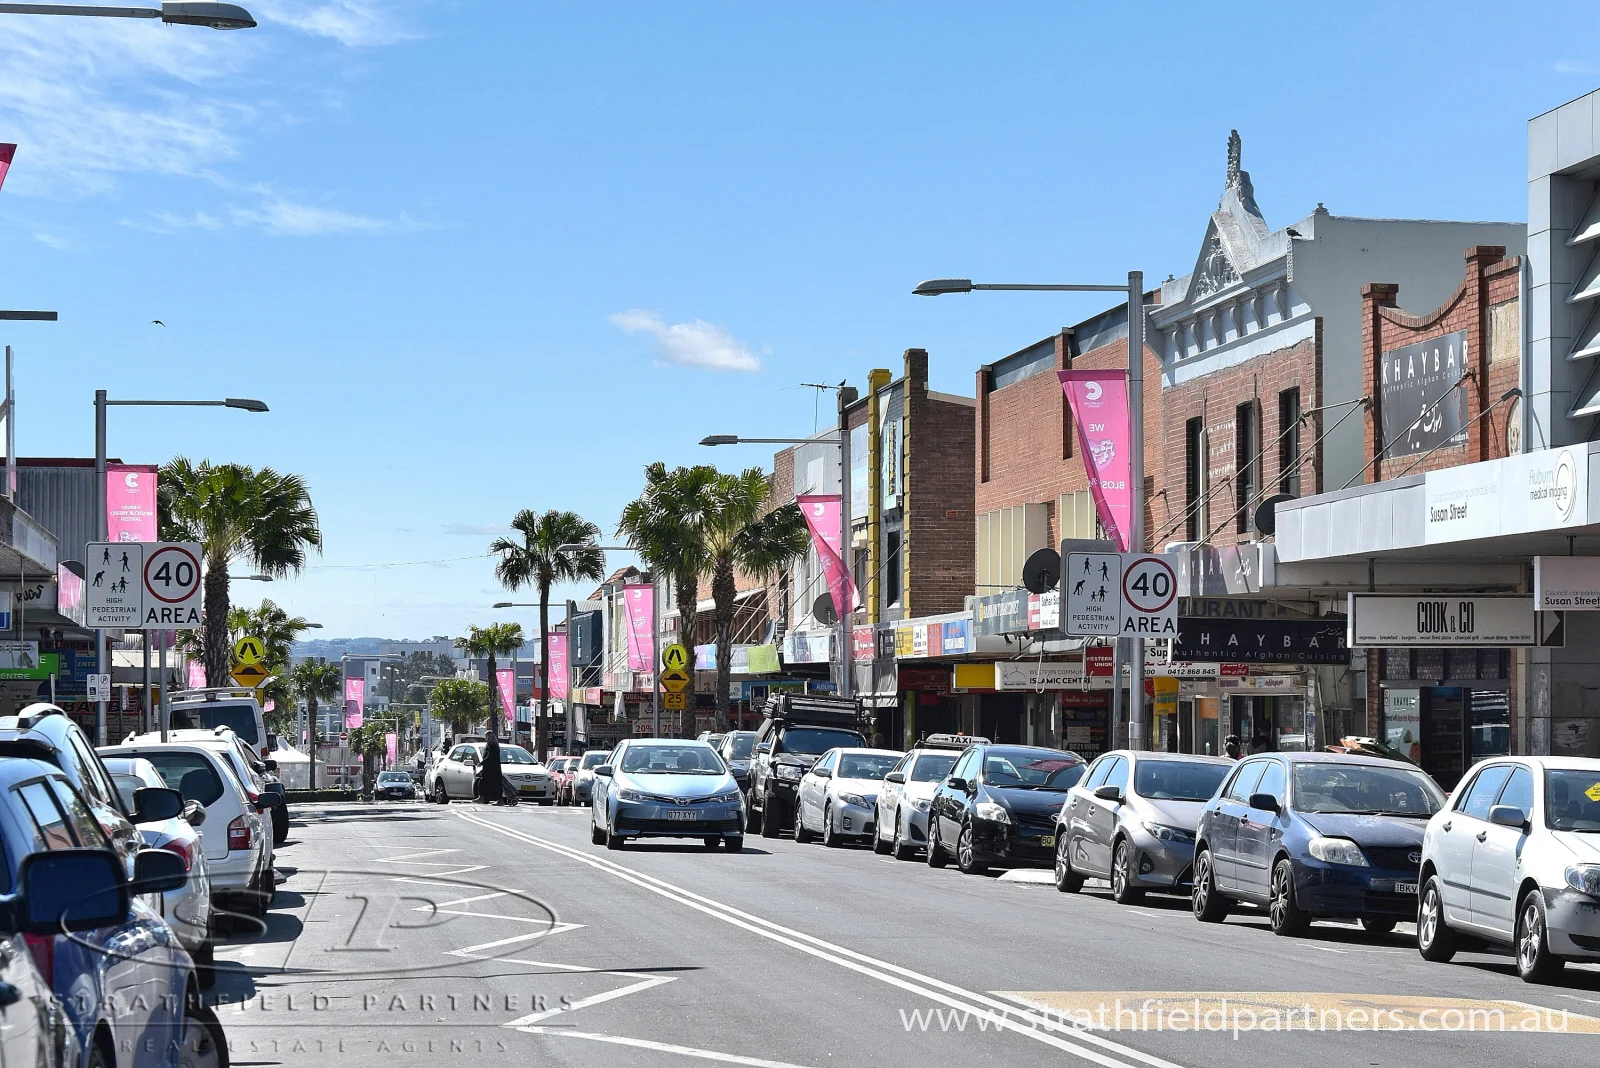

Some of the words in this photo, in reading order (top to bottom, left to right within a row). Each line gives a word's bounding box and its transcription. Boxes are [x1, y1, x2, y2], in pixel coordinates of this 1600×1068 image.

[1382, 340, 1469, 385] KHAYBAR
[1529, 468, 1554, 485] Auburn
[1530, 489, 1548, 500] medical
[1549, 486, 1568, 500] imaging
[1430, 504, 1449, 523] Susan
[1450, 501, 1468, 521] Street
[153, 562, 194, 587] 40
[1181, 558, 1224, 577] AYBAR
[1131, 572, 1170, 597] 40
[1545, 596, 1571, 605] Susan
[1574, 596, 1600, 605] Street
[146, 607, 200, 624] AREA
[1417, 601, 1448, 633] COOK
[1450, 615, 1456, 632] &
[1459, 601, 1475, 633] CO
[1123, 616, 1176, 633] AREA
[1174, 632, 1345, 649] KHAYBAR
[1173, 649, 1237, 657] Authentic
[1245, 651, 1290, 660] Afghan
[1298, 652, 1345, 661] Cuisine
[668, 694, 681, 704] 25
[1400, 884, 1418, 893] BKV
